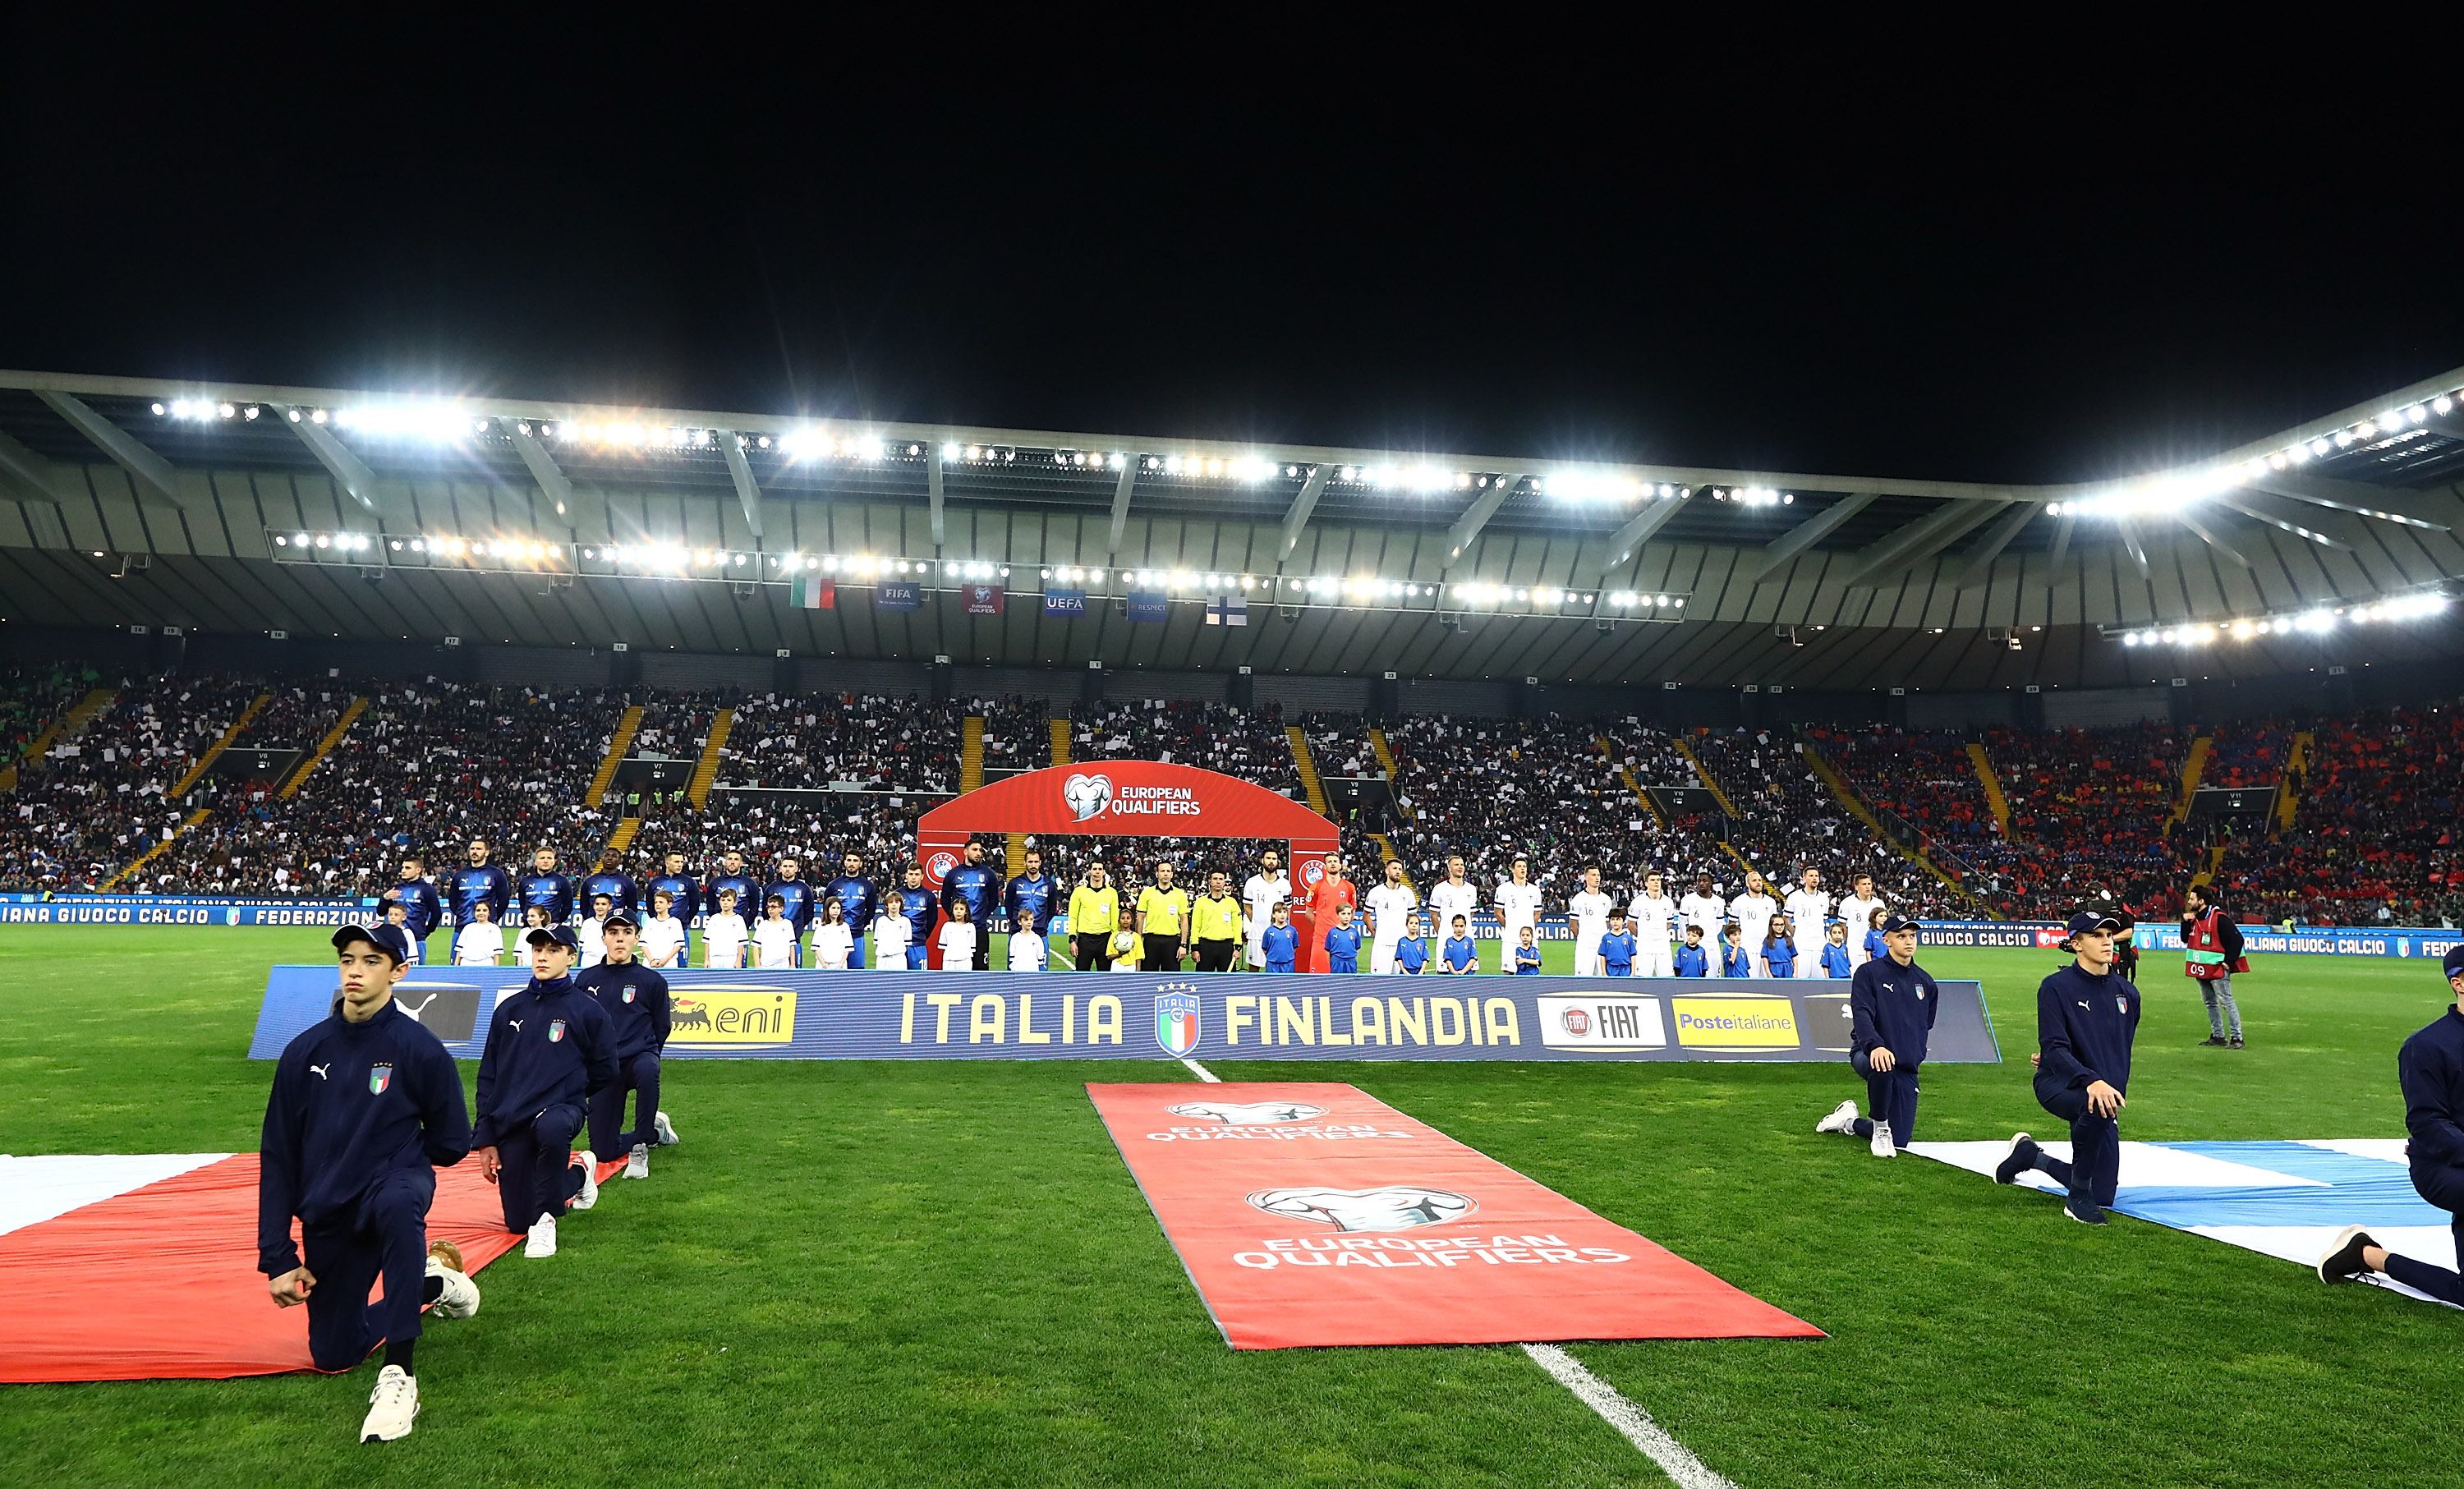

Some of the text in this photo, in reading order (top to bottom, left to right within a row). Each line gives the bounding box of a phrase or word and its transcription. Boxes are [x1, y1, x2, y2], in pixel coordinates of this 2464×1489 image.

[885, 588, 912, 599] FIFA
[1047, 597, 1083, 609] UEFA
[1121, 786, 1192, 800] EUROPEAN
[1111, 799, 1201, 816] QUALIFIERS
[933, 854, 953, 863] UEFA
[1305, 862, 1323, 870] UEFA
[1257, 893, 1266, 903] 14
[1449, 898, 1453, 908] 2
[1511, 898, 1516, 908] 5
[1384, 902, 1389, 911] 4
[1584, 907, 1593, 917] 16
[57, 908, 131, 923] GIUOCO
[138, 908, 209, 924] CALCIO
[1645, 912, 1651, 921] 3
[1694, 909, 1699, 919] 6
[1747, 910, 1757, 920] 10
[1802, 908, 1811, 917] 21
[1855, 912, 1862, 922] 8
[1921, 932, 2030, 946] GIUOCO CALCIO
[2289, 938, 2335, 954] GIUOCO
[2338, 939, 2386, 955] CALCIO
[918, 958, 928, 971] 18
[2190, 963, 2205, 976] 09
[1159, 998, 1196, 1009] ITALIA
[716, 995, 783, 1033] eni
[899, 993, 1124, 1046] ITALIA
[1225, 995, 1522, 1046] FINLANDIA
[1568, 1015, 1587, 1030] FIAT
[1597, 1005, 1639, 1039] FIAT
[1169, 1124, 1377, 1133] EUROPEAN
[1146, 1131, 1415, 1142] QUALIFIERS
[1262, 1234, 1570, 1252] EUROPEAN
[1232, 1247, 1632, 1271] QUALIFIERS
